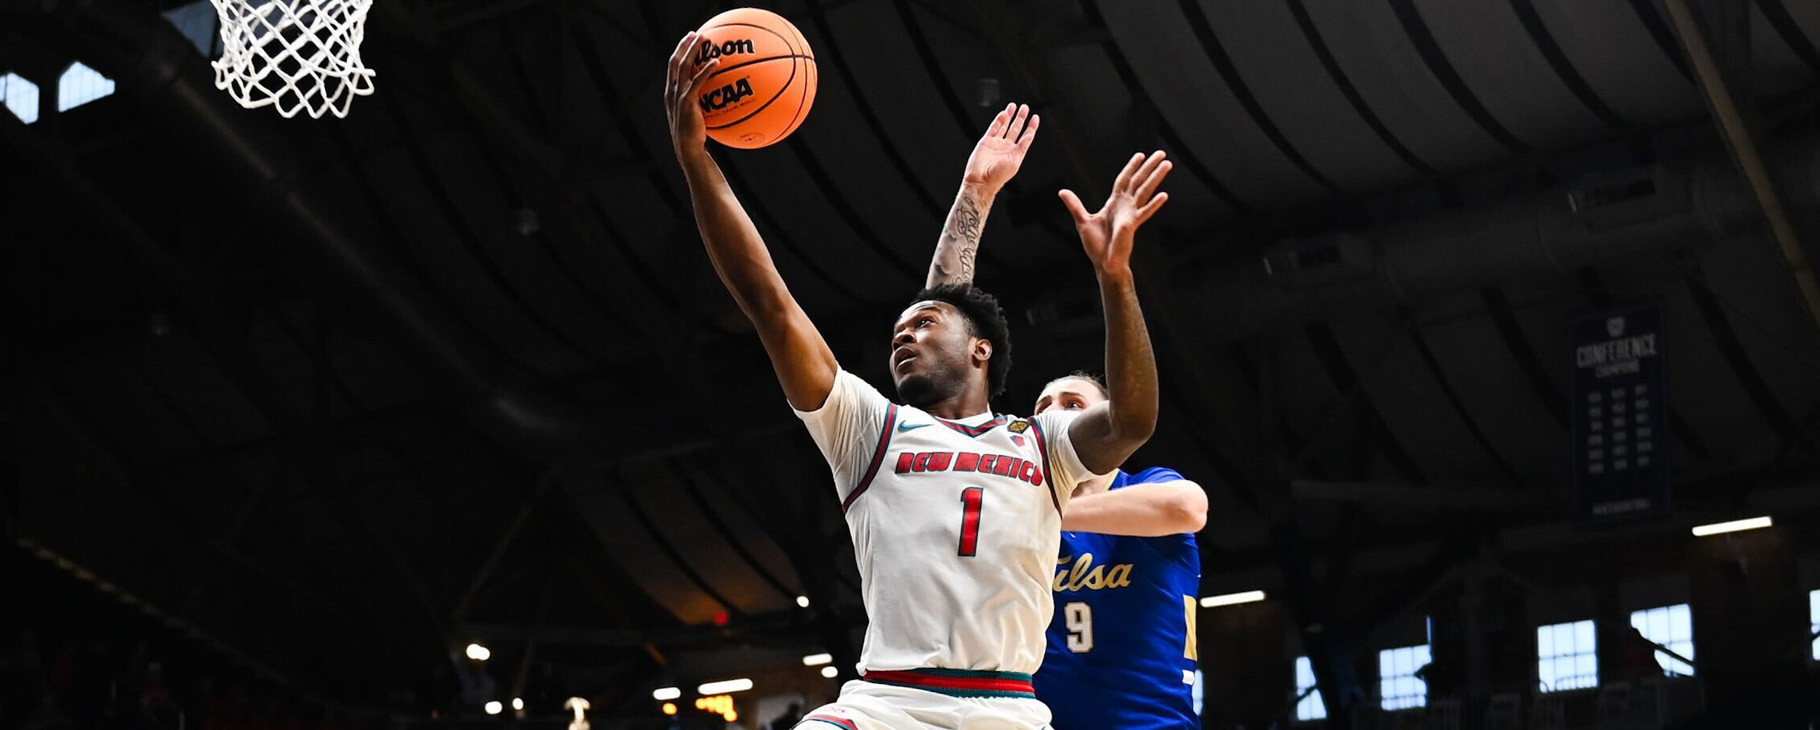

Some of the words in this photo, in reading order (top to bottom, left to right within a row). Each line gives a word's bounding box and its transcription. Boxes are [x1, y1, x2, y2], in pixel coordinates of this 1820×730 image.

[699, 77, 754, 113] NCAA
[895, 452, 954, 475] NEW
[958, 487, 984, 557] 1
[1052, 552, 1134, 592] ulsa
[1064, 601, 1094, 653] 9
